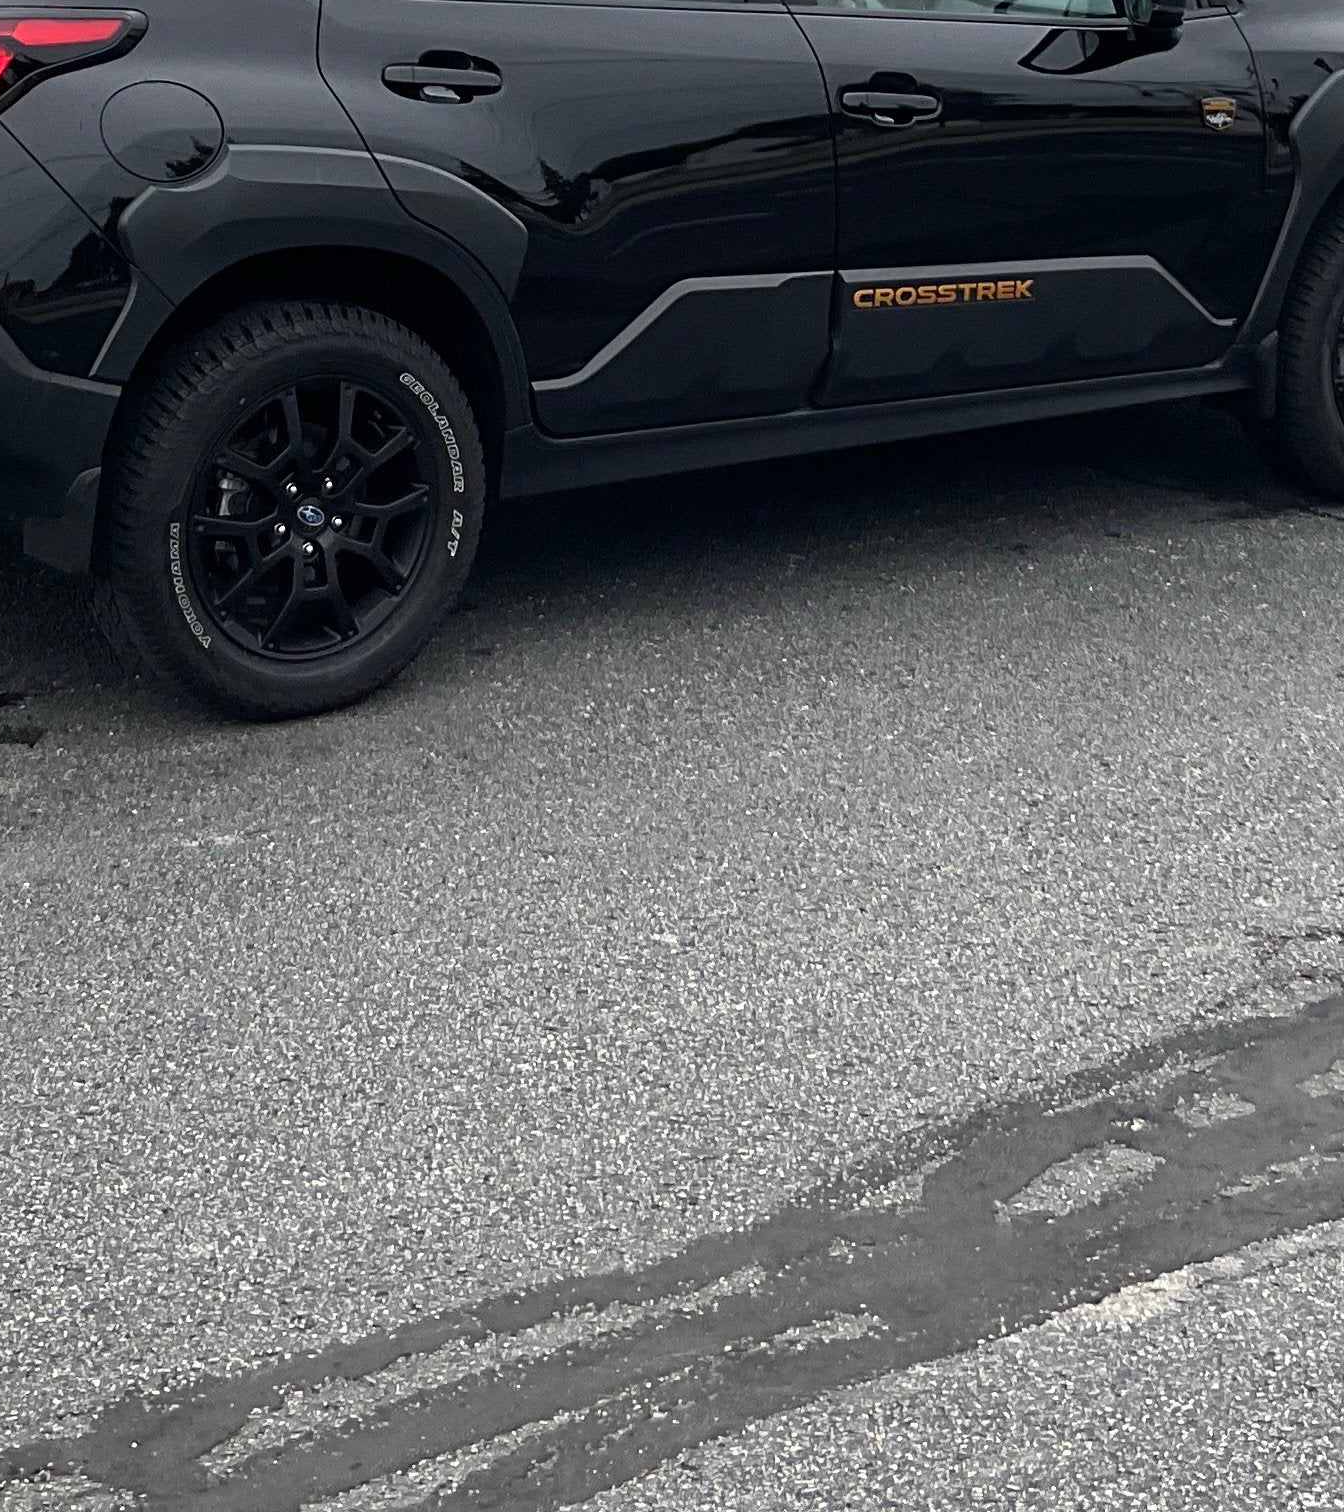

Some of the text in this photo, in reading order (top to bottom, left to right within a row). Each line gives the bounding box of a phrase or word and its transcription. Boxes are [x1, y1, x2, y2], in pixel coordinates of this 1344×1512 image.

[853, 279, 1034, 309] CROSSTREK
[399, 373, 465, 557] GEOLANDAR A/T
[170, 522, 212, 649] YOKOHAMA
